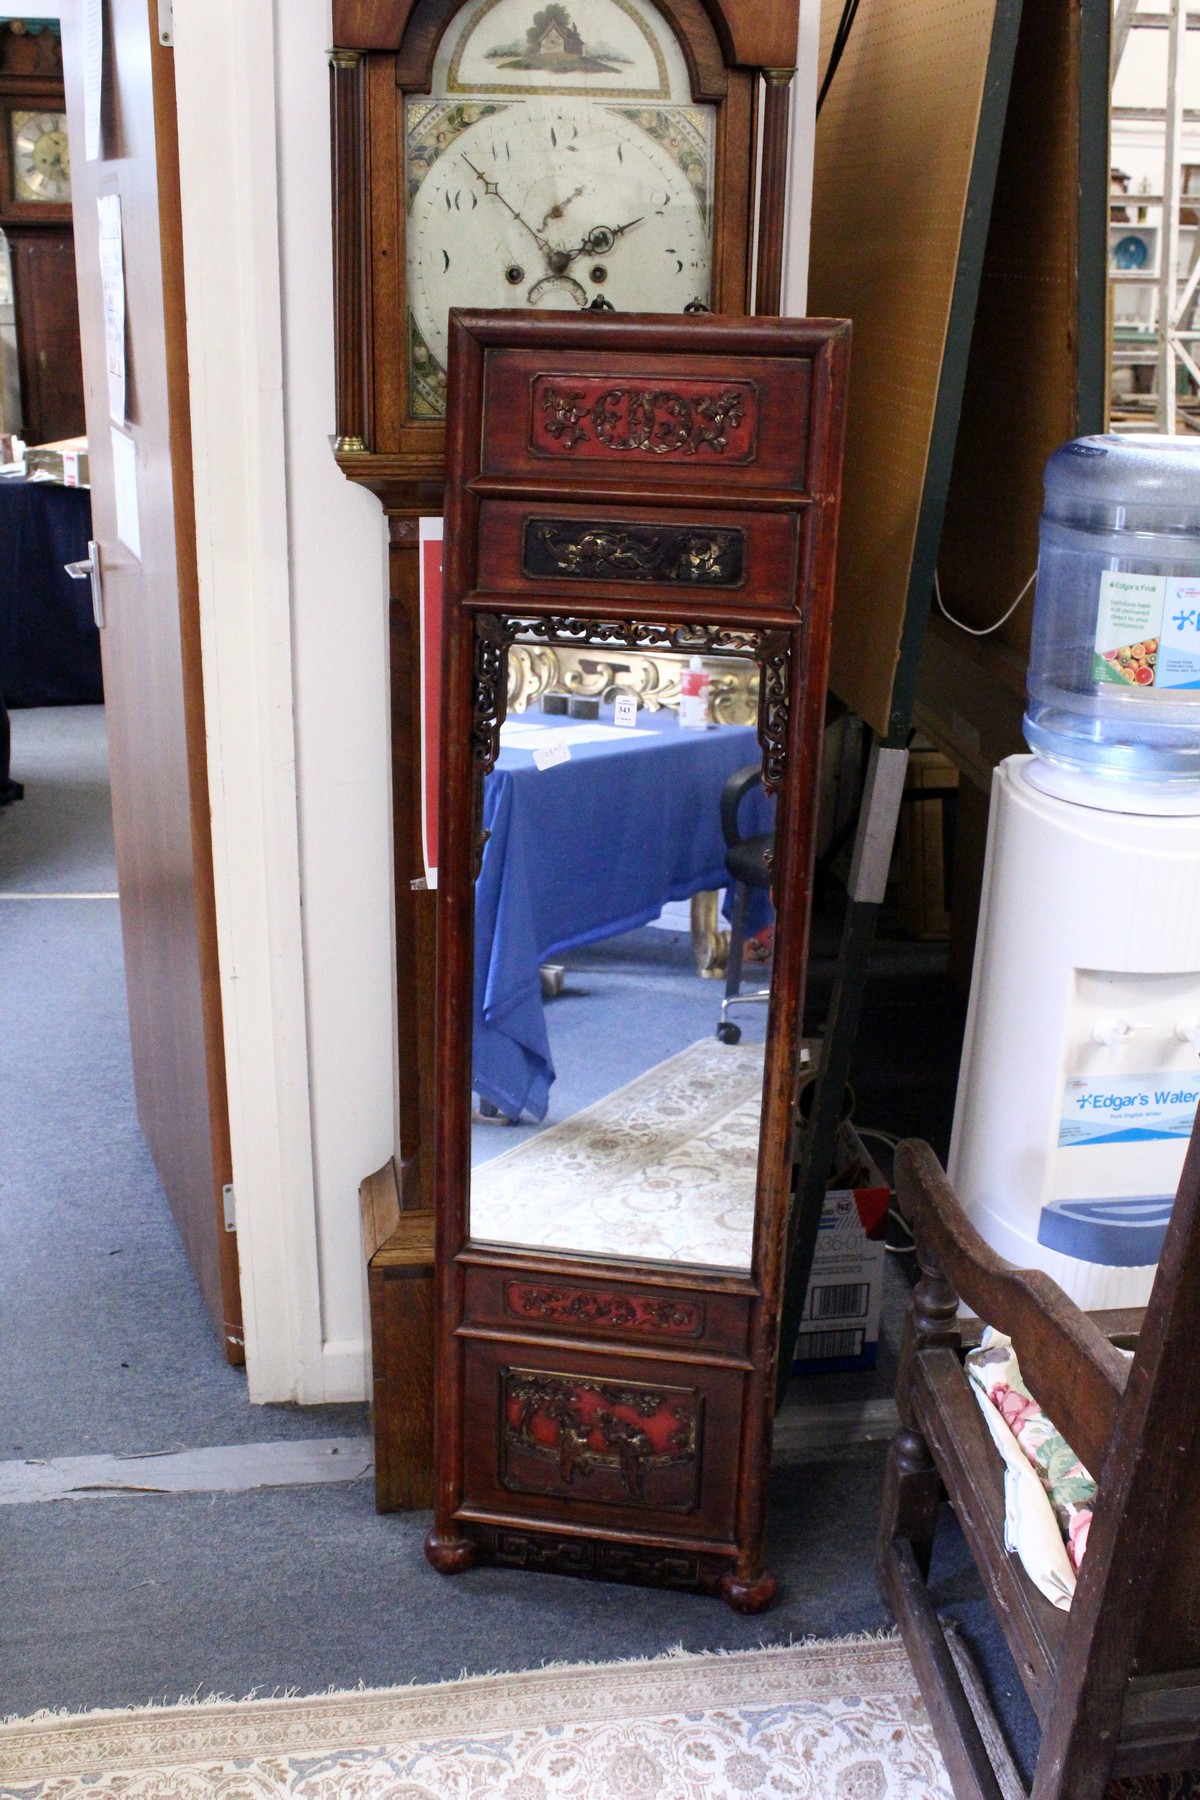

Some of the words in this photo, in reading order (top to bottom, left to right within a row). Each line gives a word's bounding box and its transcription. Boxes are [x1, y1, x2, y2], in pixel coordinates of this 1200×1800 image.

[1115, 582, 1140, 592] Edgar's
[1141, 583, 1157, 592] Fruit
[1093, 1093, 1148, 1111] Edgar's
[1154, 1090, 1200, 1105] Water
[1124, 1112, 1144, 1120] English
